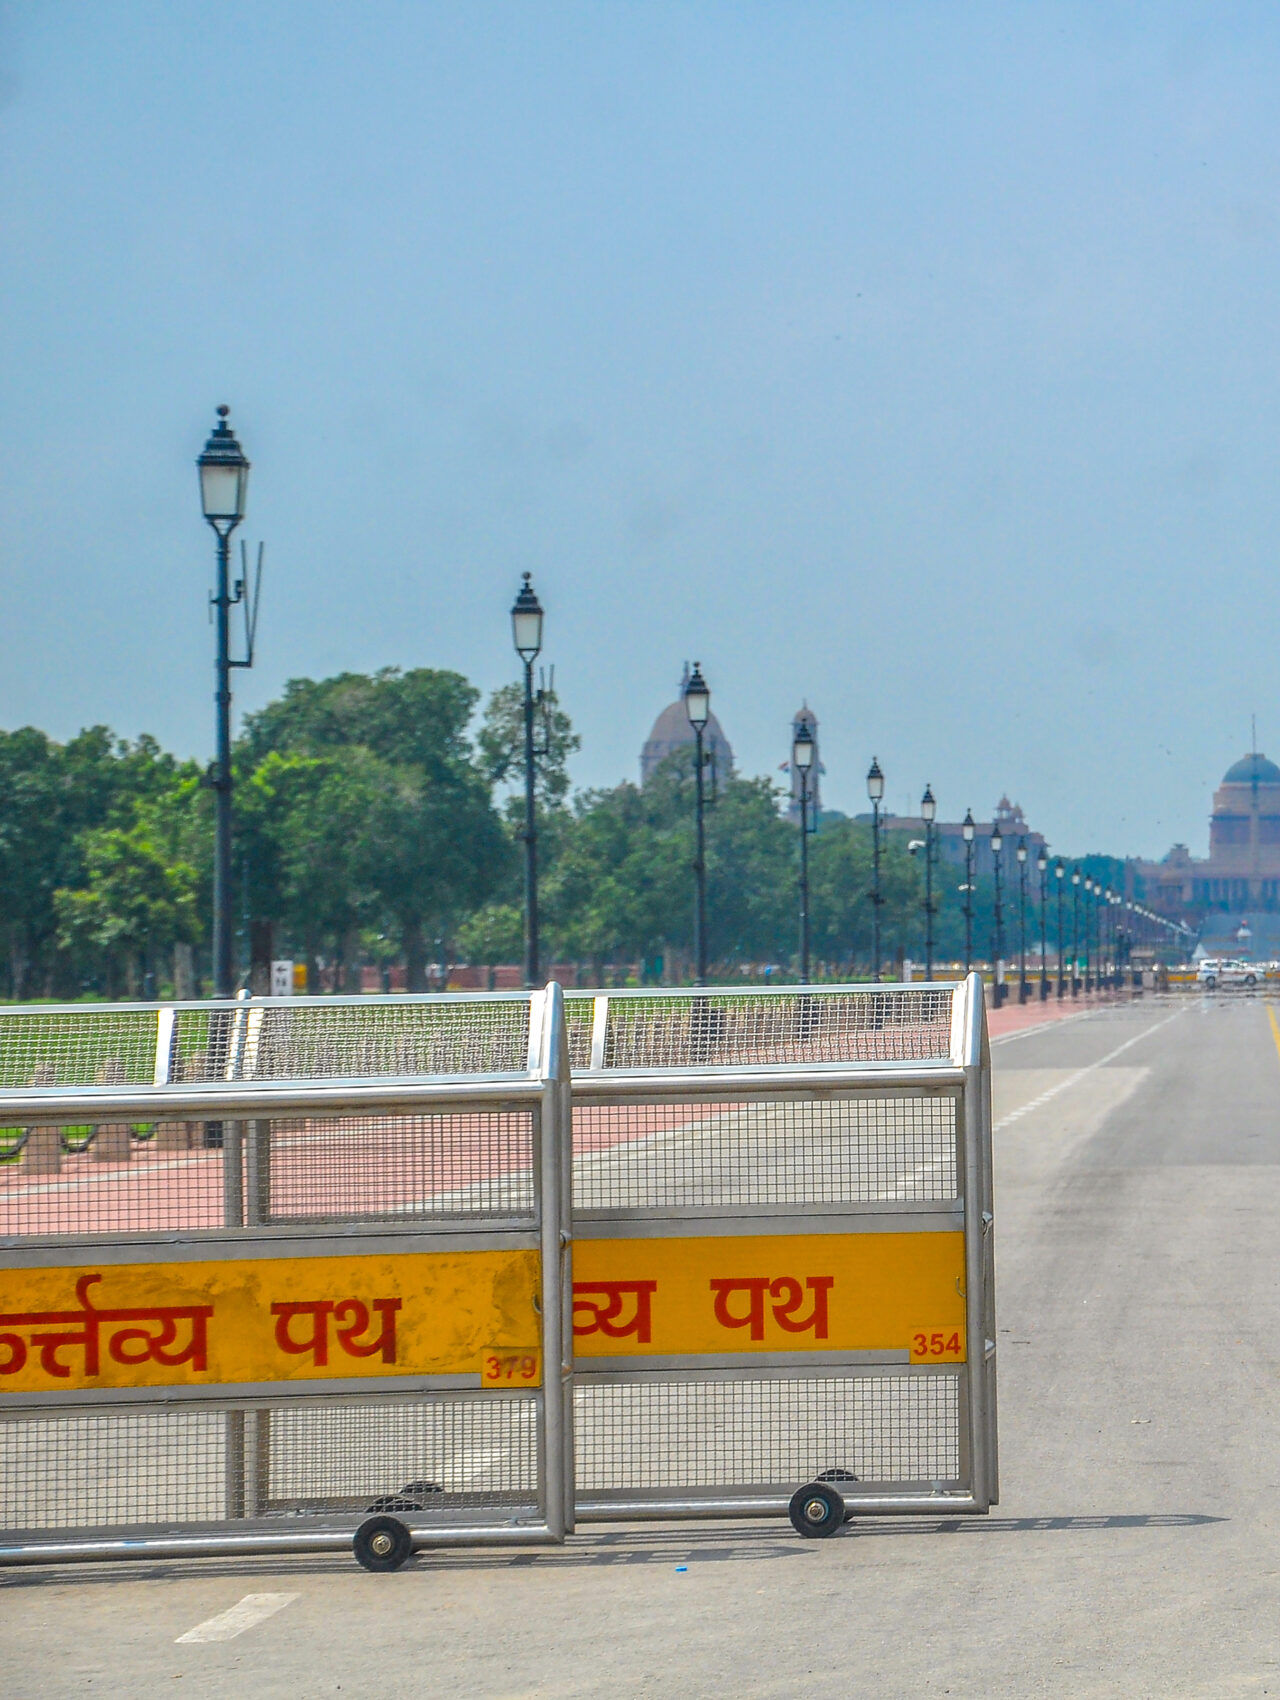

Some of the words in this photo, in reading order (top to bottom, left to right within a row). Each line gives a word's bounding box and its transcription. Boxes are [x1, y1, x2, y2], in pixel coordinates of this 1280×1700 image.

[709, 1276, 835, 1342] पथ
[271, 1298, 402, 1367] पथ
[913, 1331, 962, 1357] 354
[486, 1356, 537, 1380] 379
